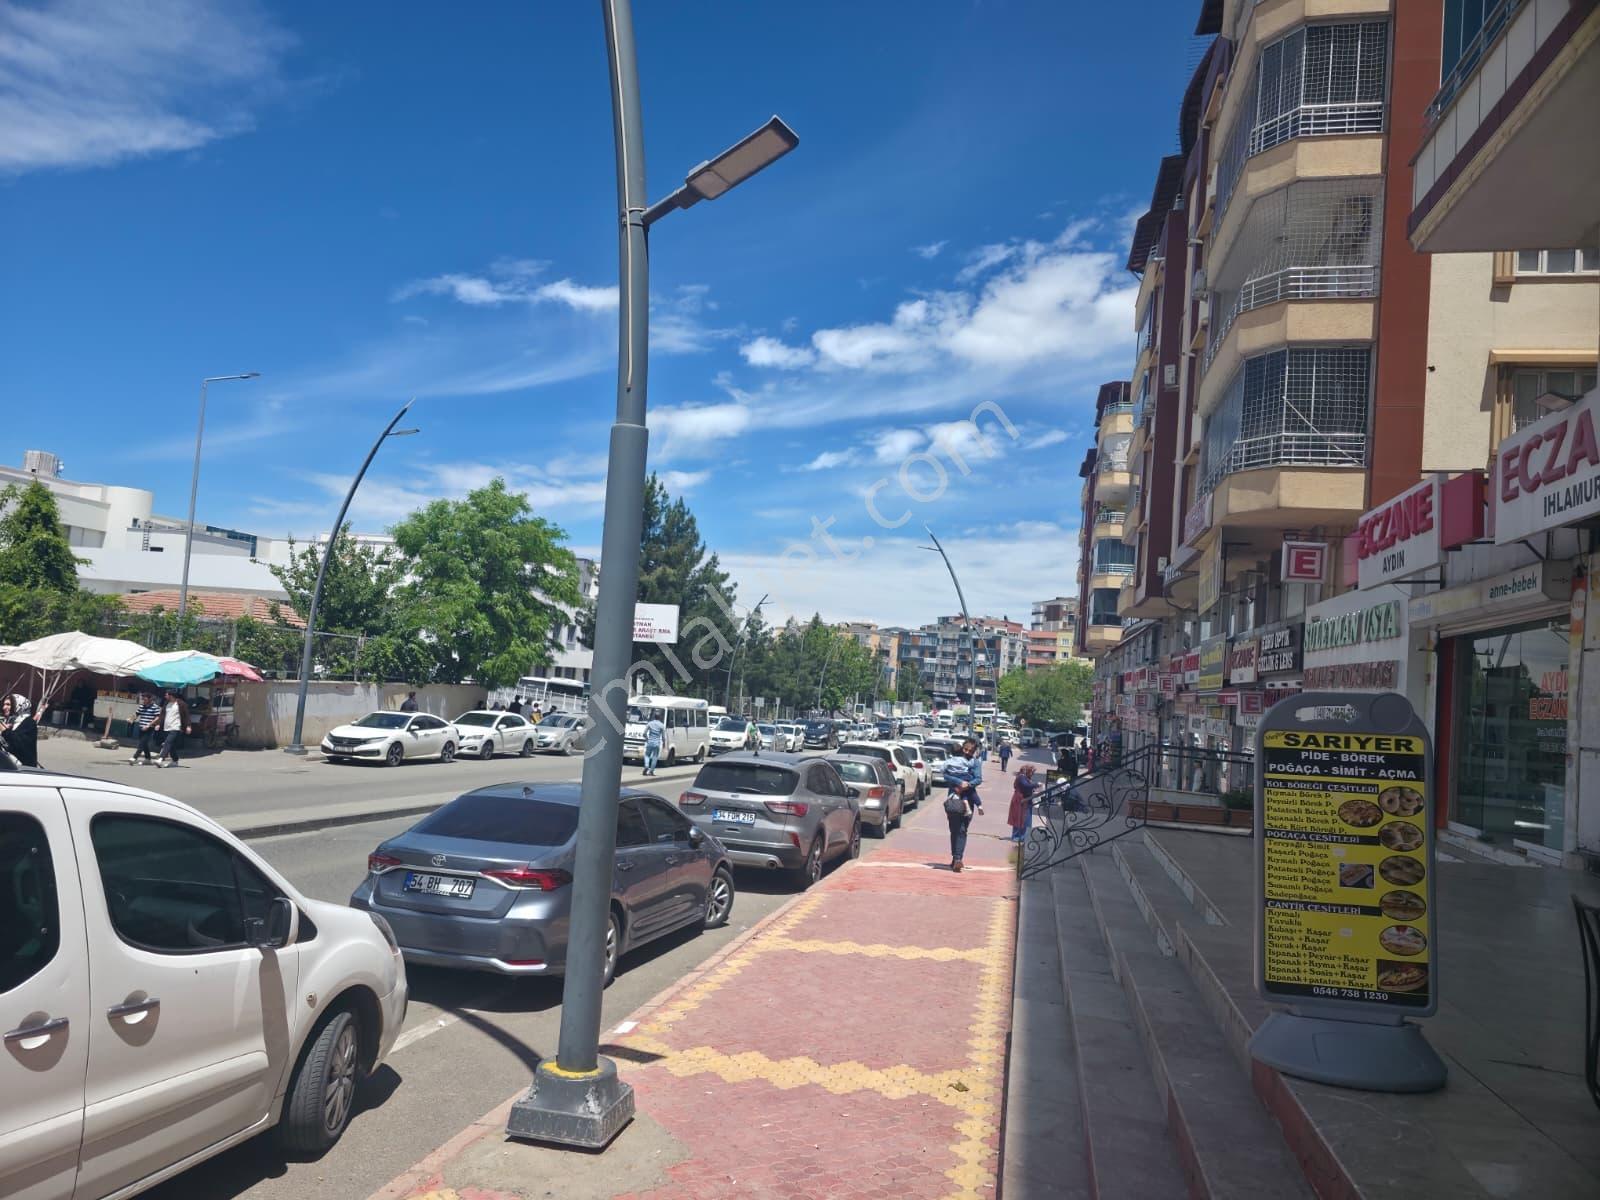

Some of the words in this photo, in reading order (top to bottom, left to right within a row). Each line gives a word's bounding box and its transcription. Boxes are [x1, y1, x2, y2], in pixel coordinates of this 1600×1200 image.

[1358, 483, 1434, 560] ECZANE
[1294, 551, 1317, 575] E
[1383, 550, 1405, 575] AYDIN
[1489, 572, 1537, 598] anne-bebek
[1361, 603, 1397, 642] USTA
[1283, 733, 1414, 752] SARIYER
[1301, 751, 1330, 761] PİDE
[1341, 752, 1385, 763] BÖREK
[1269, 763, 1320, 775] POĞAÇA
[1332, 766, 1367, 777] SİMİT
[1379, 769, 1416, 780] AÇMA
[411, 875, 424, 887] 54
[427, 877, 442, 889] BH
[451, 879, 473, 893] 707
[1313, 986, 1338, 996] 0546
